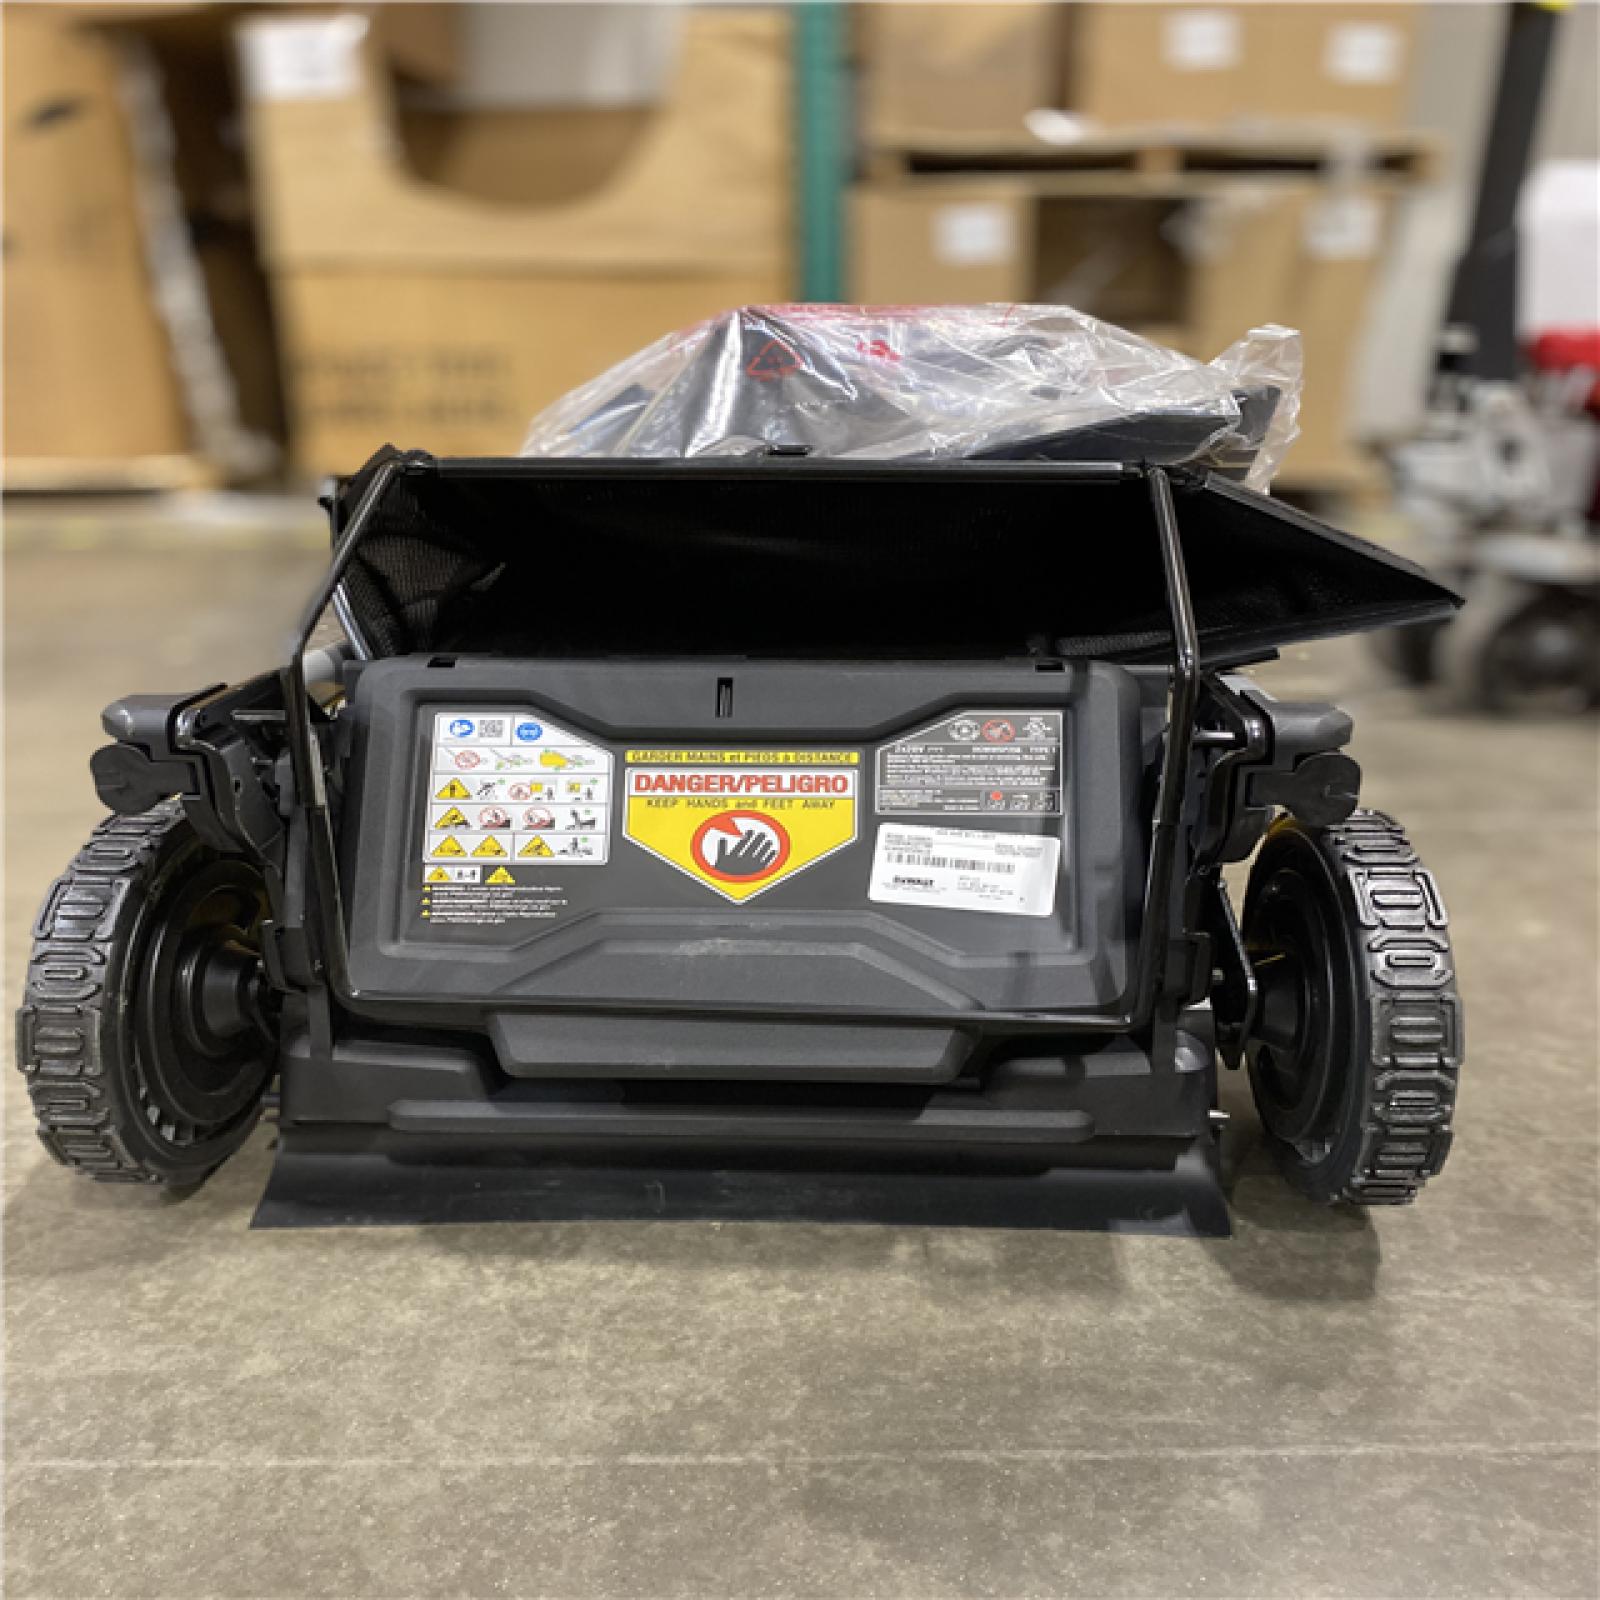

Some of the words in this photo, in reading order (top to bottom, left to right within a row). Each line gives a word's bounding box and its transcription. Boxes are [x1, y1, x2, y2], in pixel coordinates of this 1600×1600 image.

[632, 751, 683, 763] GARDER
[686, 751, 725, 763] MAINS
[744, 751, 779, 763] PIEDS
[794, 752, 851, 763] DISTANCE
[635, 774, 849, 793] DANGER/PELIGRO
[647, 798, 678, 808] KEEP
[687, 798, 728, 808] HANDS
[734, 798, 757, 808] and
[762, 798, 793, 808] FEET
[802, 798, 835, 808] AWAY
